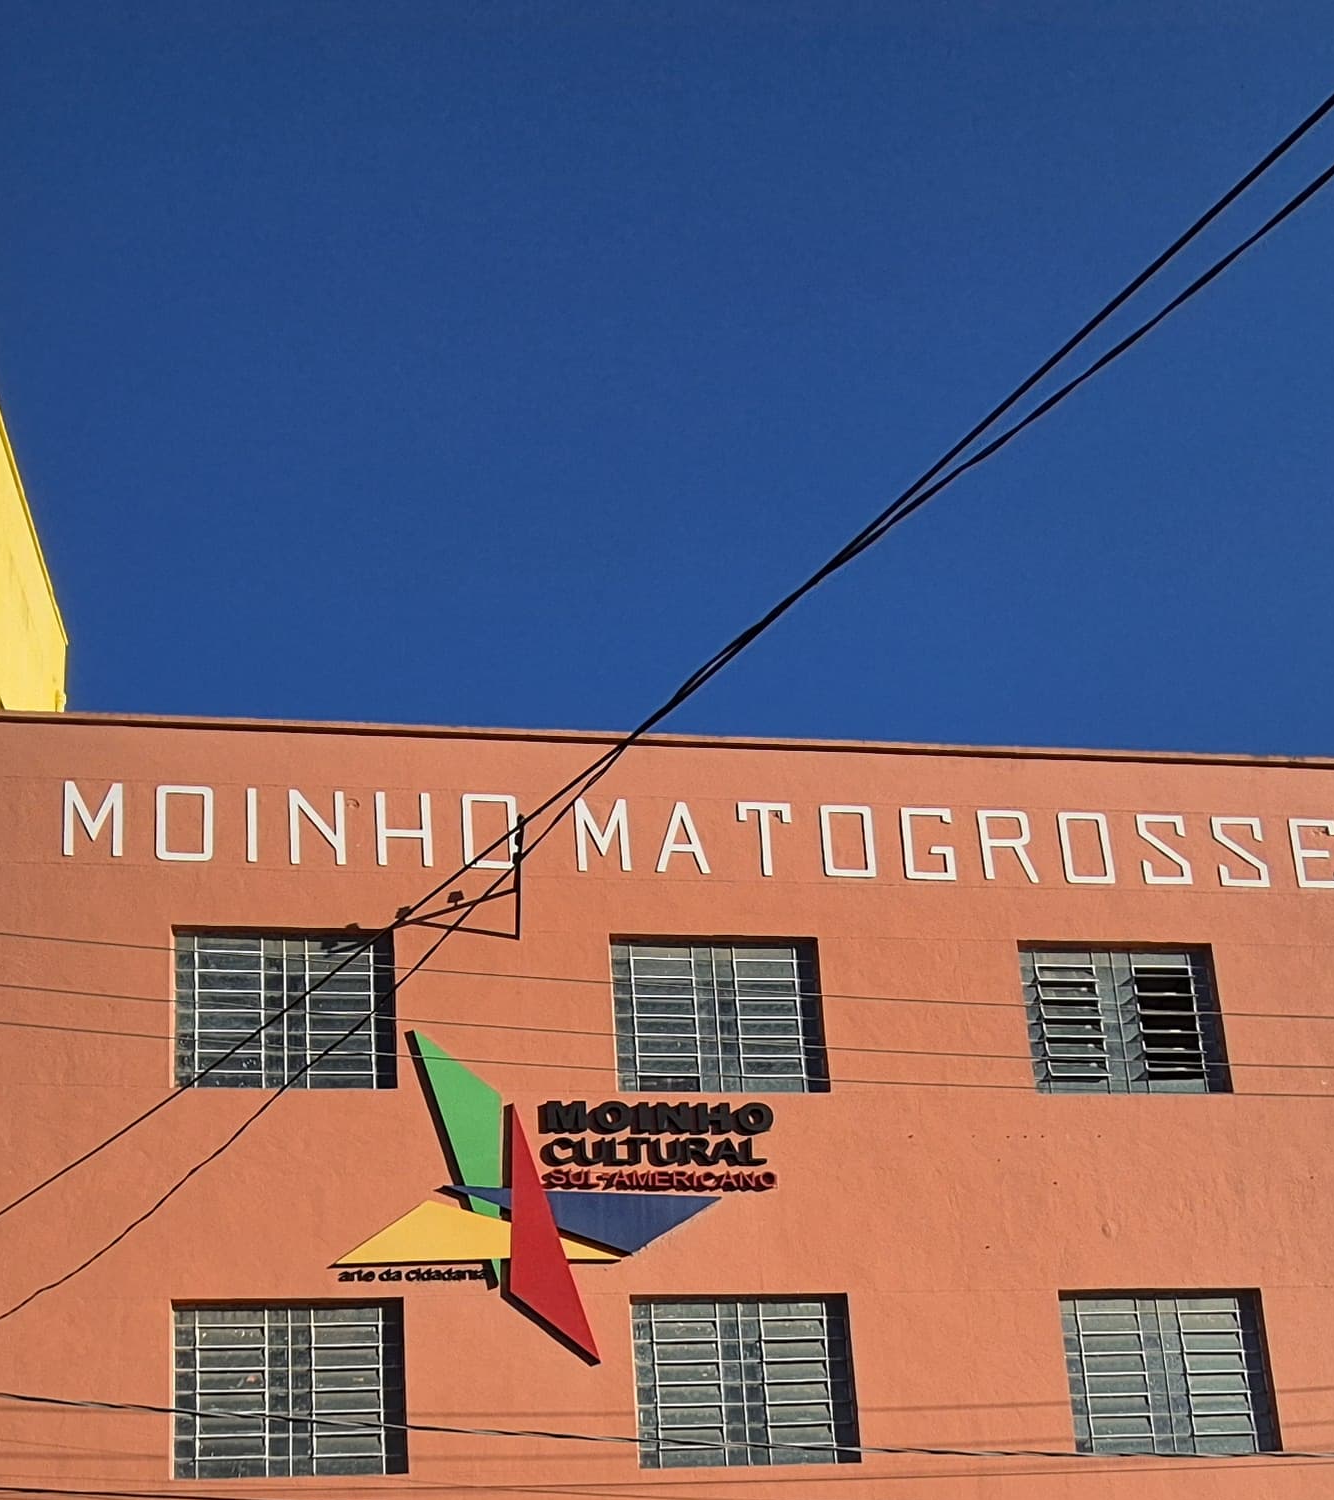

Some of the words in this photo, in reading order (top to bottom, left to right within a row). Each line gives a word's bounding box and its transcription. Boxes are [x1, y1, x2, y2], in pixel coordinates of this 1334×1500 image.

[62, 780, 519, 869] MOINHO
[538, 1101, 774, 1135] MOINHO
[540, 1137, 767, 1167] CULTURAL
[378, 1268, 402, 1282] da
